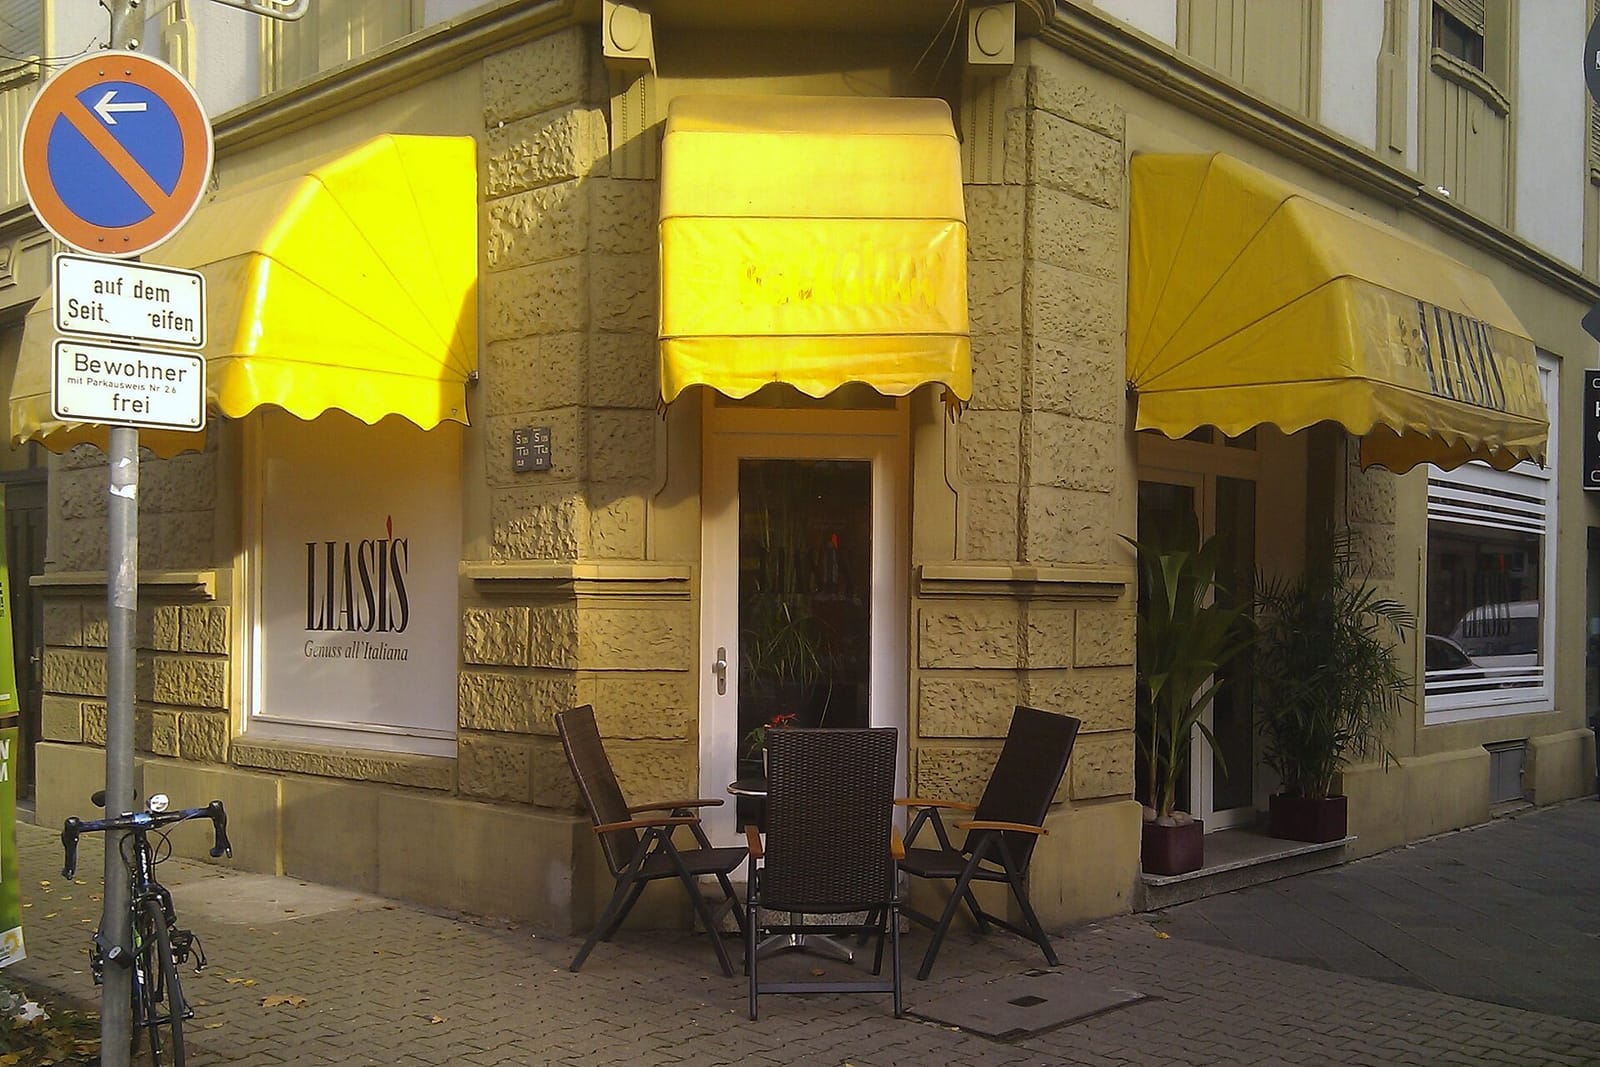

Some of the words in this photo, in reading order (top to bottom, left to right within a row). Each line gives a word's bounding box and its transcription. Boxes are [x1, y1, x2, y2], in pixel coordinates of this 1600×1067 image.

[94, 277, 123, 296] auf
[134, 279, 170, 303] dem
[75, 353, 187, 382] Bewohner
[67, 376, 83, 385] mit
[86, 377, 146, 391] Parkausweis
[113, 393, 149, 414] frei
[304, 639, 342, 658] Genuss
